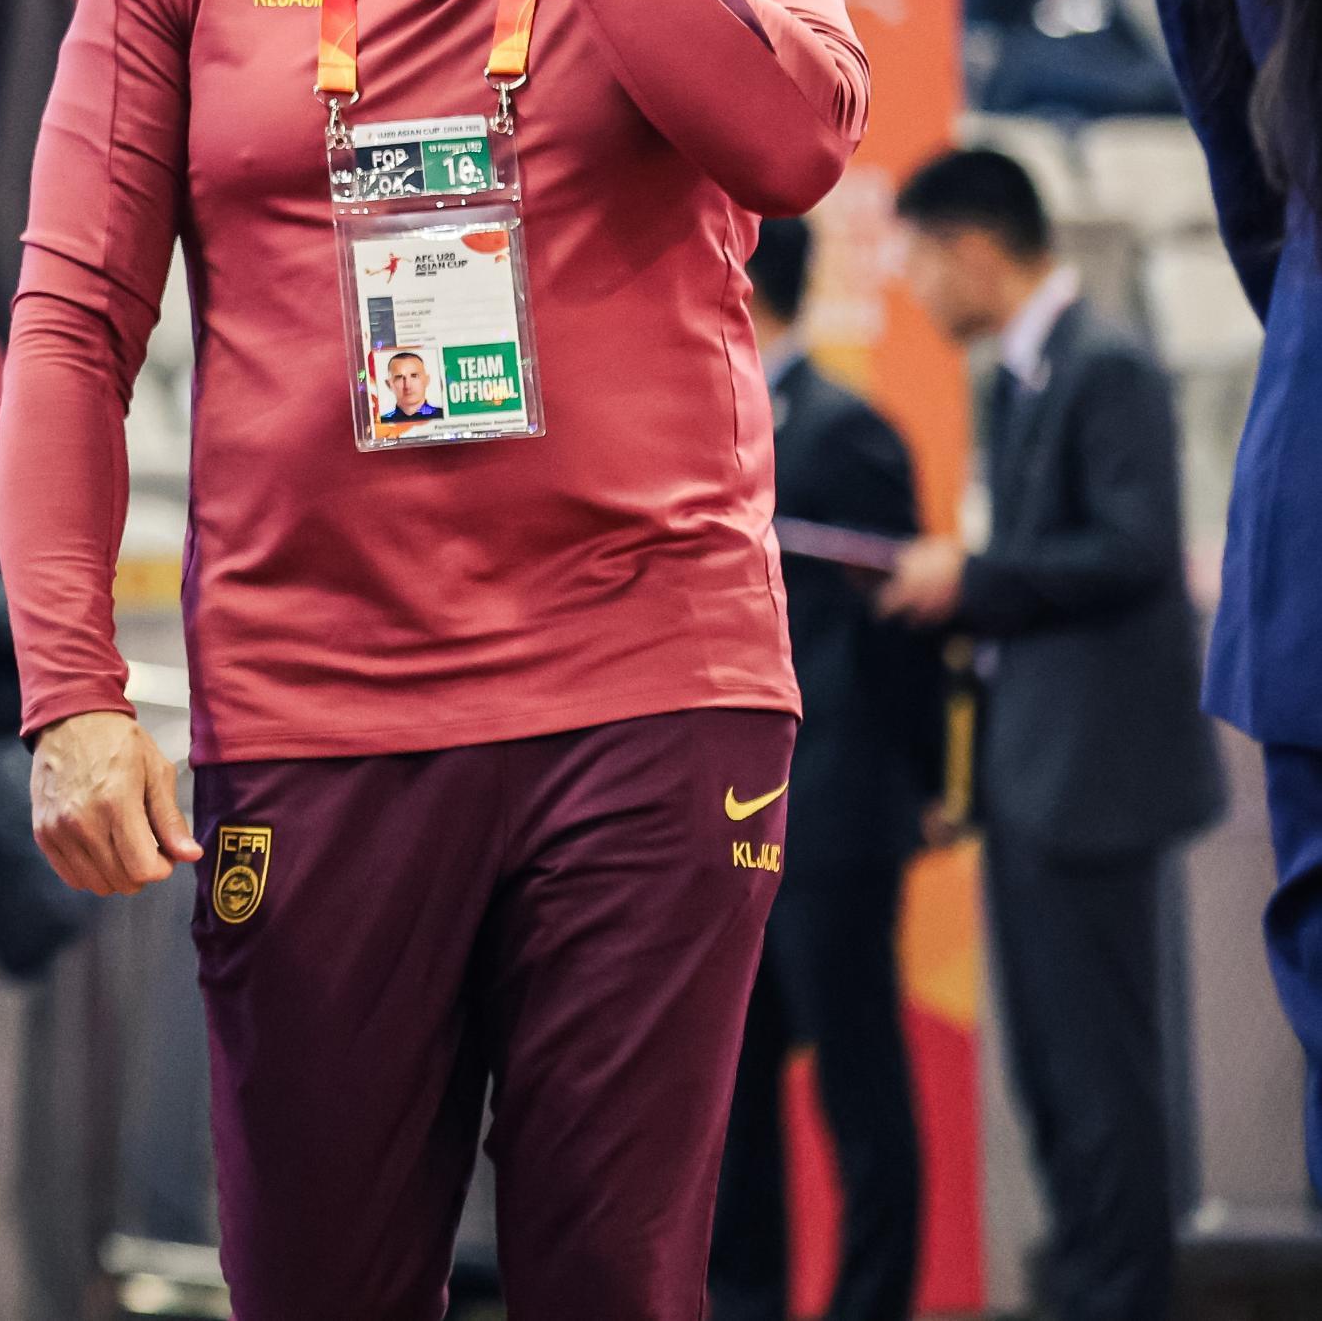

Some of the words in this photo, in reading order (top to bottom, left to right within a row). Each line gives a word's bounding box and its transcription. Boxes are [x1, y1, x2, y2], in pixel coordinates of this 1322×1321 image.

[415, 254, 435, 264] AFC
[437, 252, 456, 262] U20
[415, 263, 446, 272] ASIAN
[447, 260, 468, 269] CUP
[457, 354, 504, 380] TEAM
[224, 833, 266, 854] CFA
